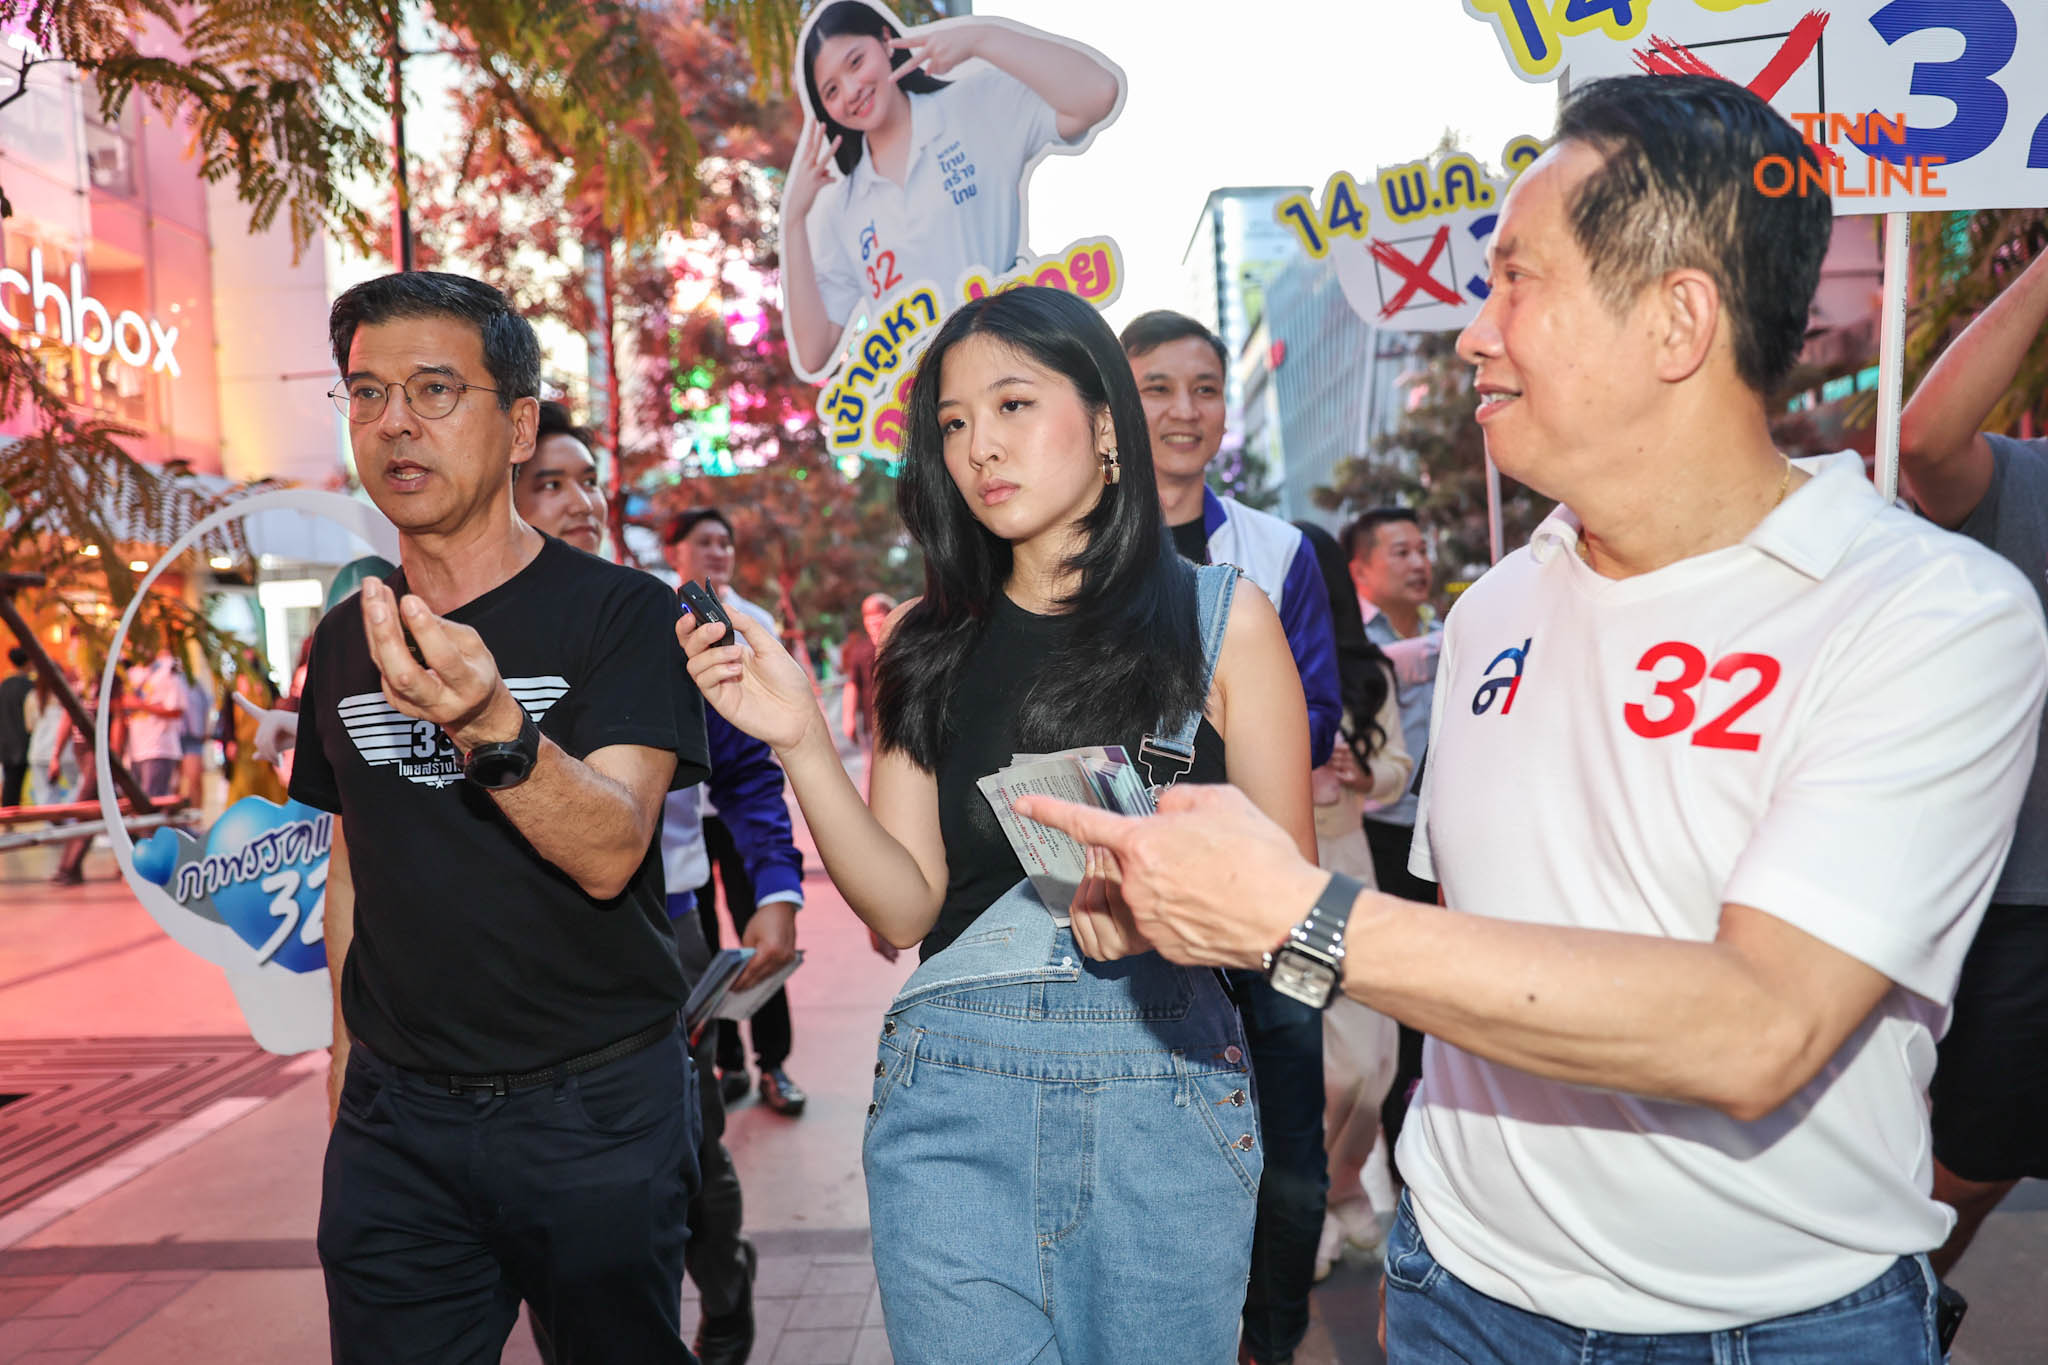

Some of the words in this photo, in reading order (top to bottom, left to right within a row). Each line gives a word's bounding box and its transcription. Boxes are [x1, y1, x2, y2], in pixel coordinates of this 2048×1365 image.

[1845, 0, 2048, 168] 3
[1285, 180, 1363, 251] 14
[1386, 164, 1490, 216] พ.ค.
[866, 249, 904, 300] 32
[827, 293, 936, 444] เข้าคูหา
[1623, 641, 1782, 752] 32
[390, 757, 463, 777] ไทยสร้างไ
